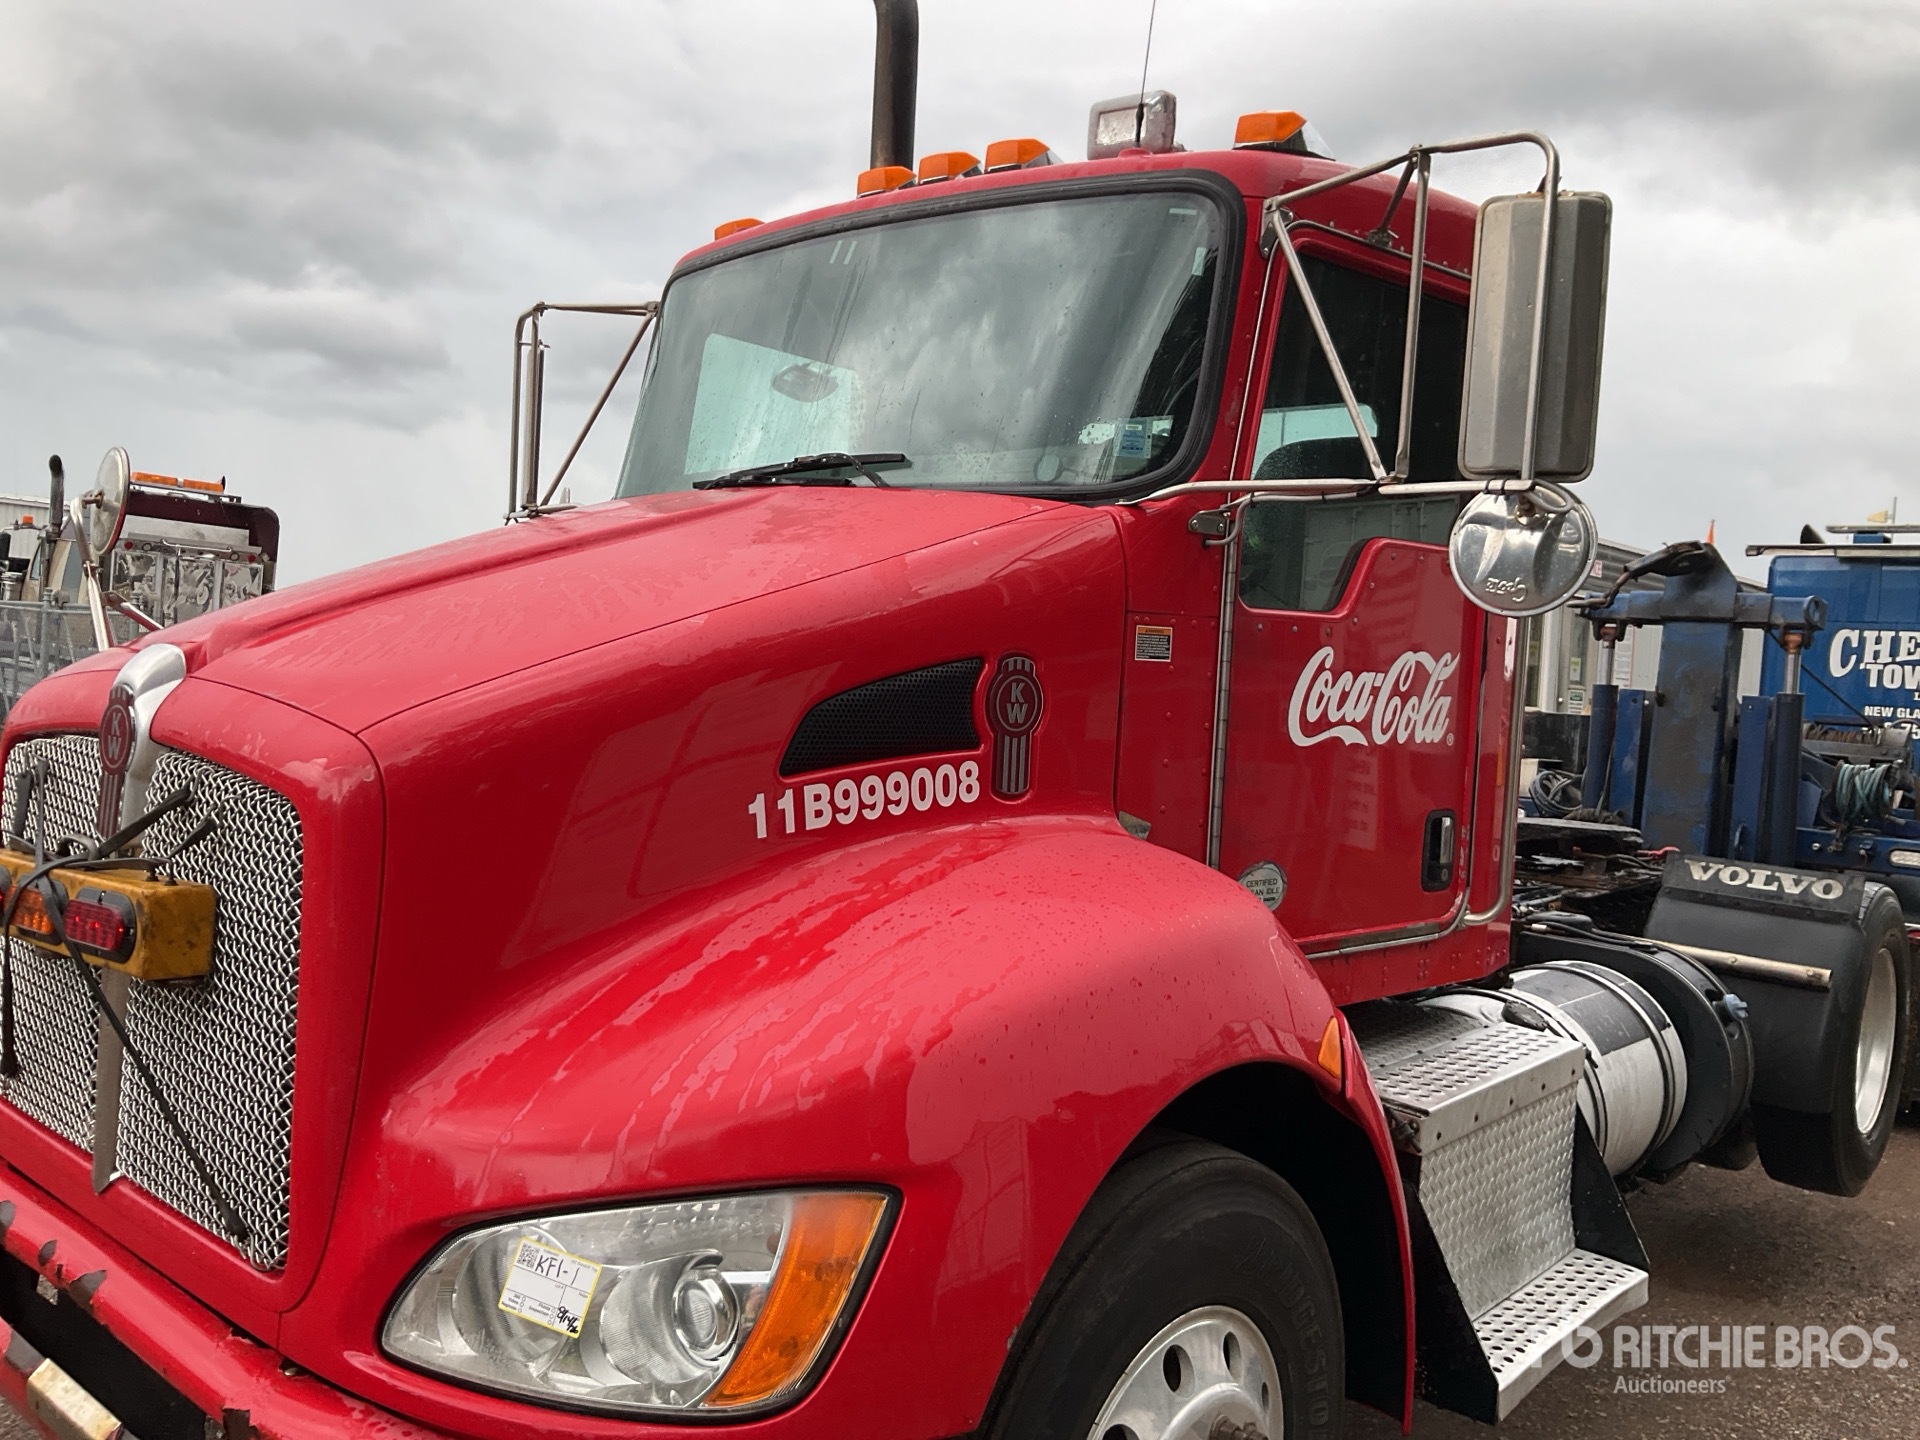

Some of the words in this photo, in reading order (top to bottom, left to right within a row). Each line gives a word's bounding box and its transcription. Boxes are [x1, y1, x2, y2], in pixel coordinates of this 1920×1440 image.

[1288, 646, 1460, 747] Coca-Cola
[1864, 706, 1894, 717] NEW
[748, 761, 980, 839] 11B999008
[1246, 878, 1278, 888] CERTIFIED
[1684, 859, 1844, 899] VOLVO
